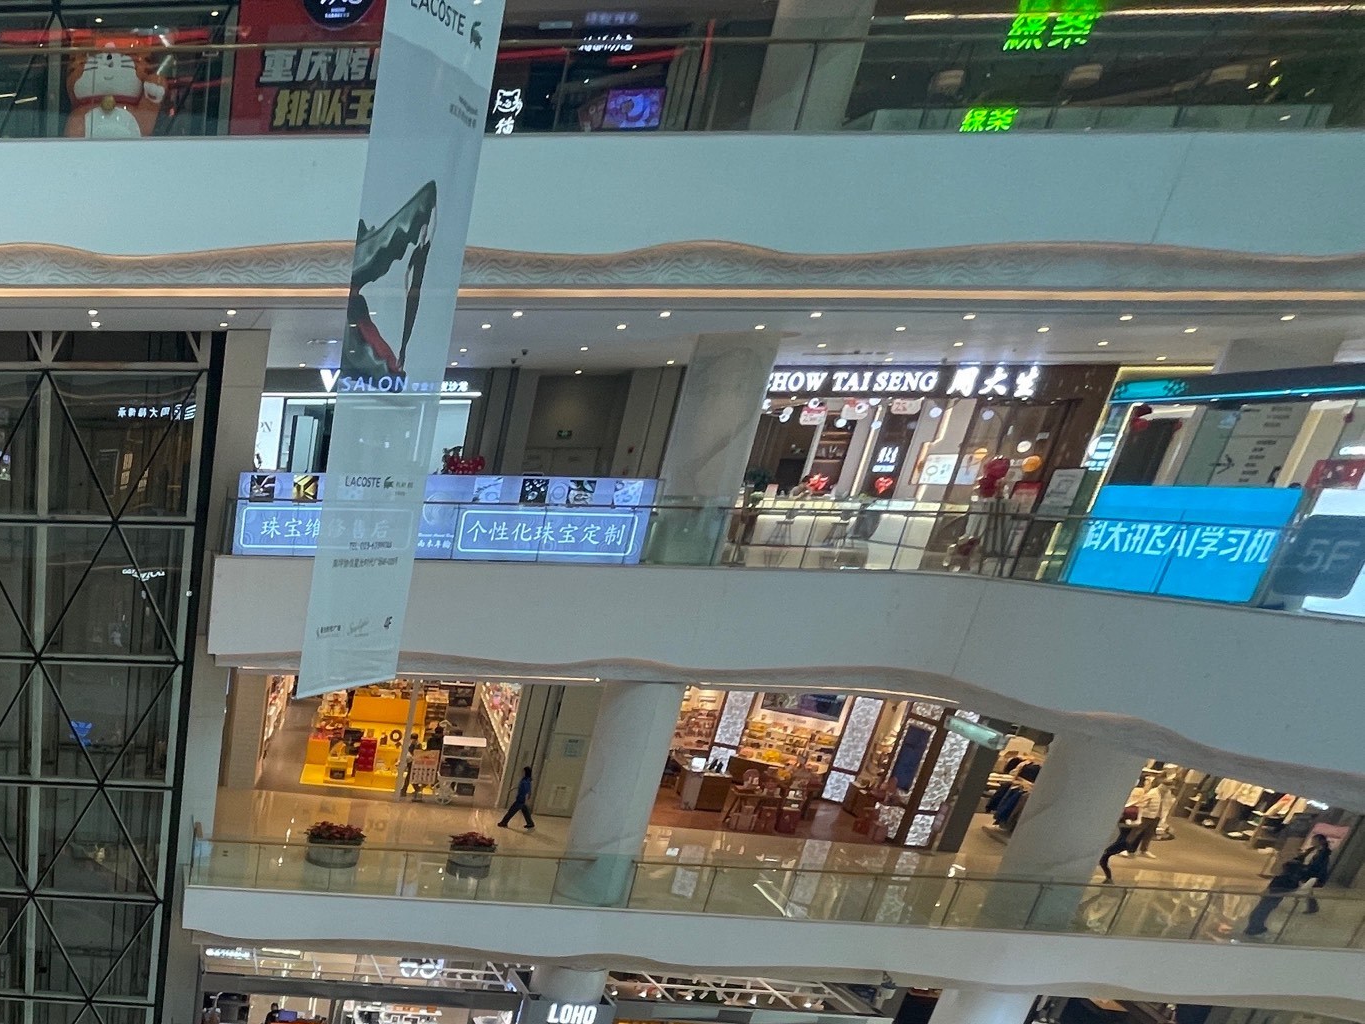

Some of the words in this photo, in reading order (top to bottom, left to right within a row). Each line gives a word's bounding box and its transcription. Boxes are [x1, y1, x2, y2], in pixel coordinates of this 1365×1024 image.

[260, 47, 378, 82] 重庆烤
[341, 376, 409, 392] SALON
[769, 371, 827, 392] HOW
[832, 372, 872, 392] TAI
[872, 371, 938, 392] SENG
[946, 366, 1040, 398] 周大生
[345, 476, 382, 488] LACOSTE
[466, 520, 627, 547] 个性化珠宝定制
[1083, 520, 1278, 563] 科大讯飞AI学习机
[1300, 538, 1364, 570] 5F
